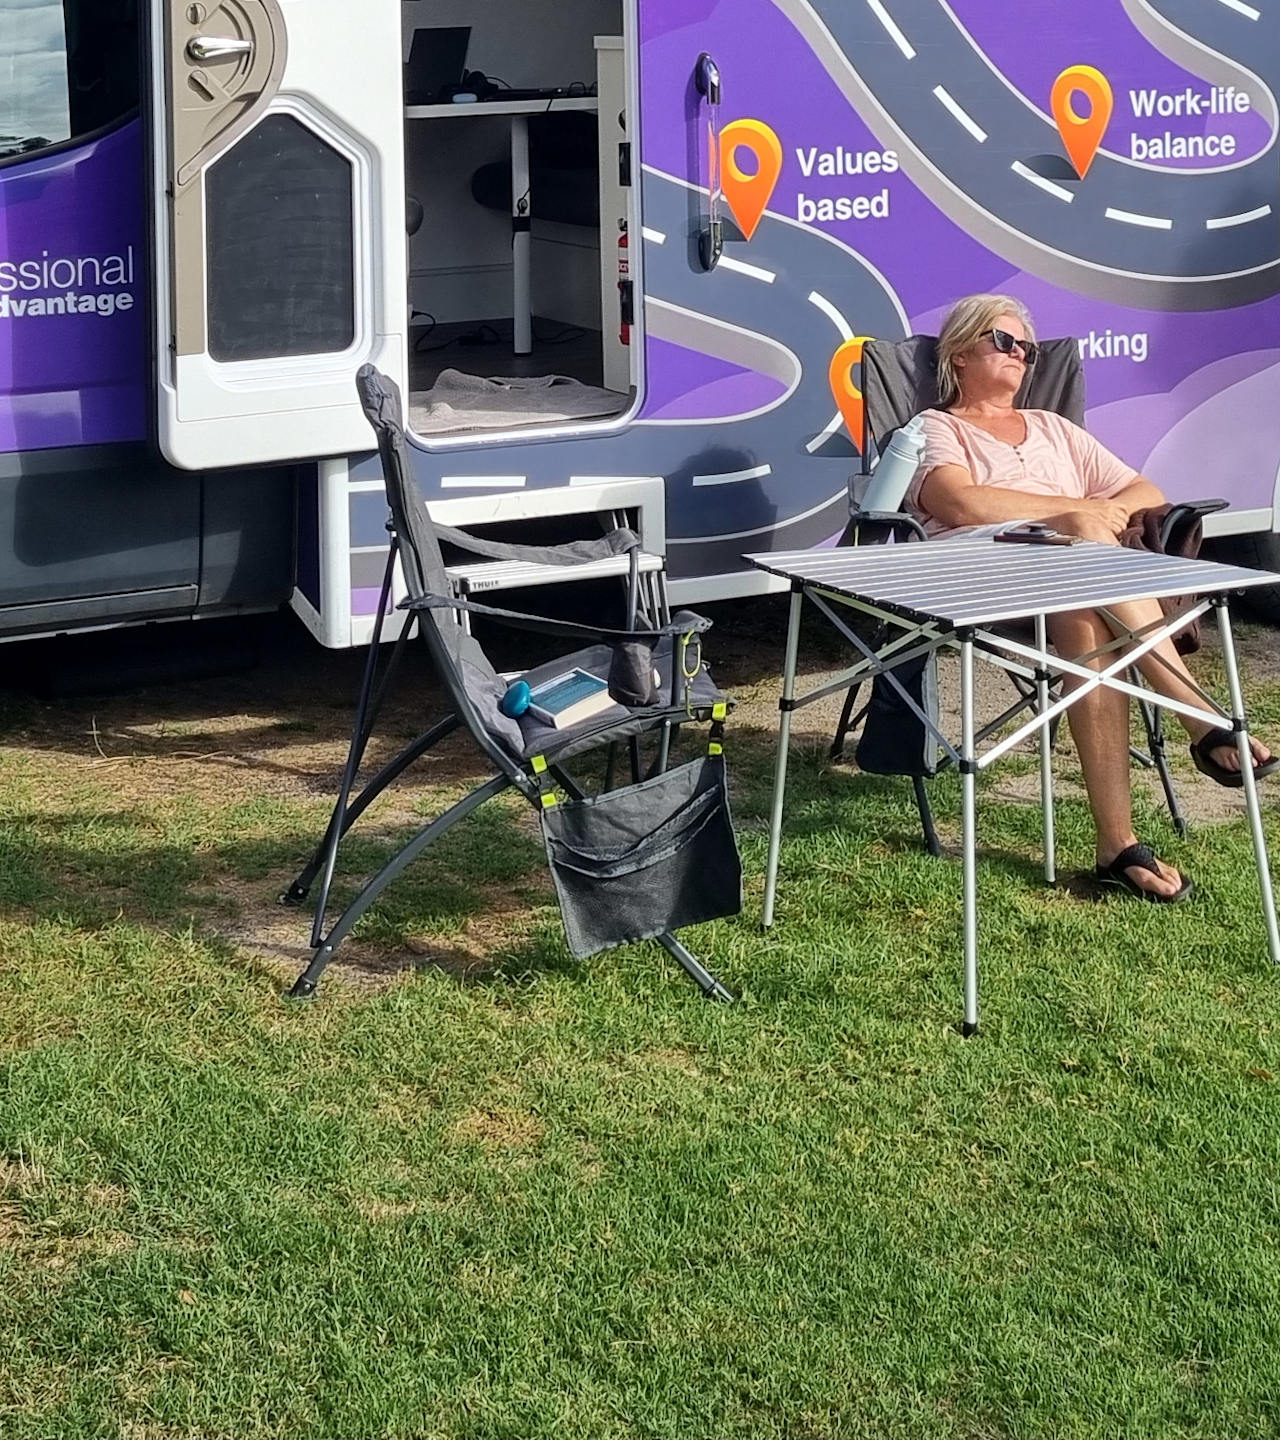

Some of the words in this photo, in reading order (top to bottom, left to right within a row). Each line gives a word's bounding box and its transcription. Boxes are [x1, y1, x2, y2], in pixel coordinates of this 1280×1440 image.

[1129, 85, 1251, 118] Work-life
[795, 145, 900, 177] Values
[1130, 132, 1237, 162] balance
[796, 189, 890, 224] based
[1077, 328, 1148, 363] rking
